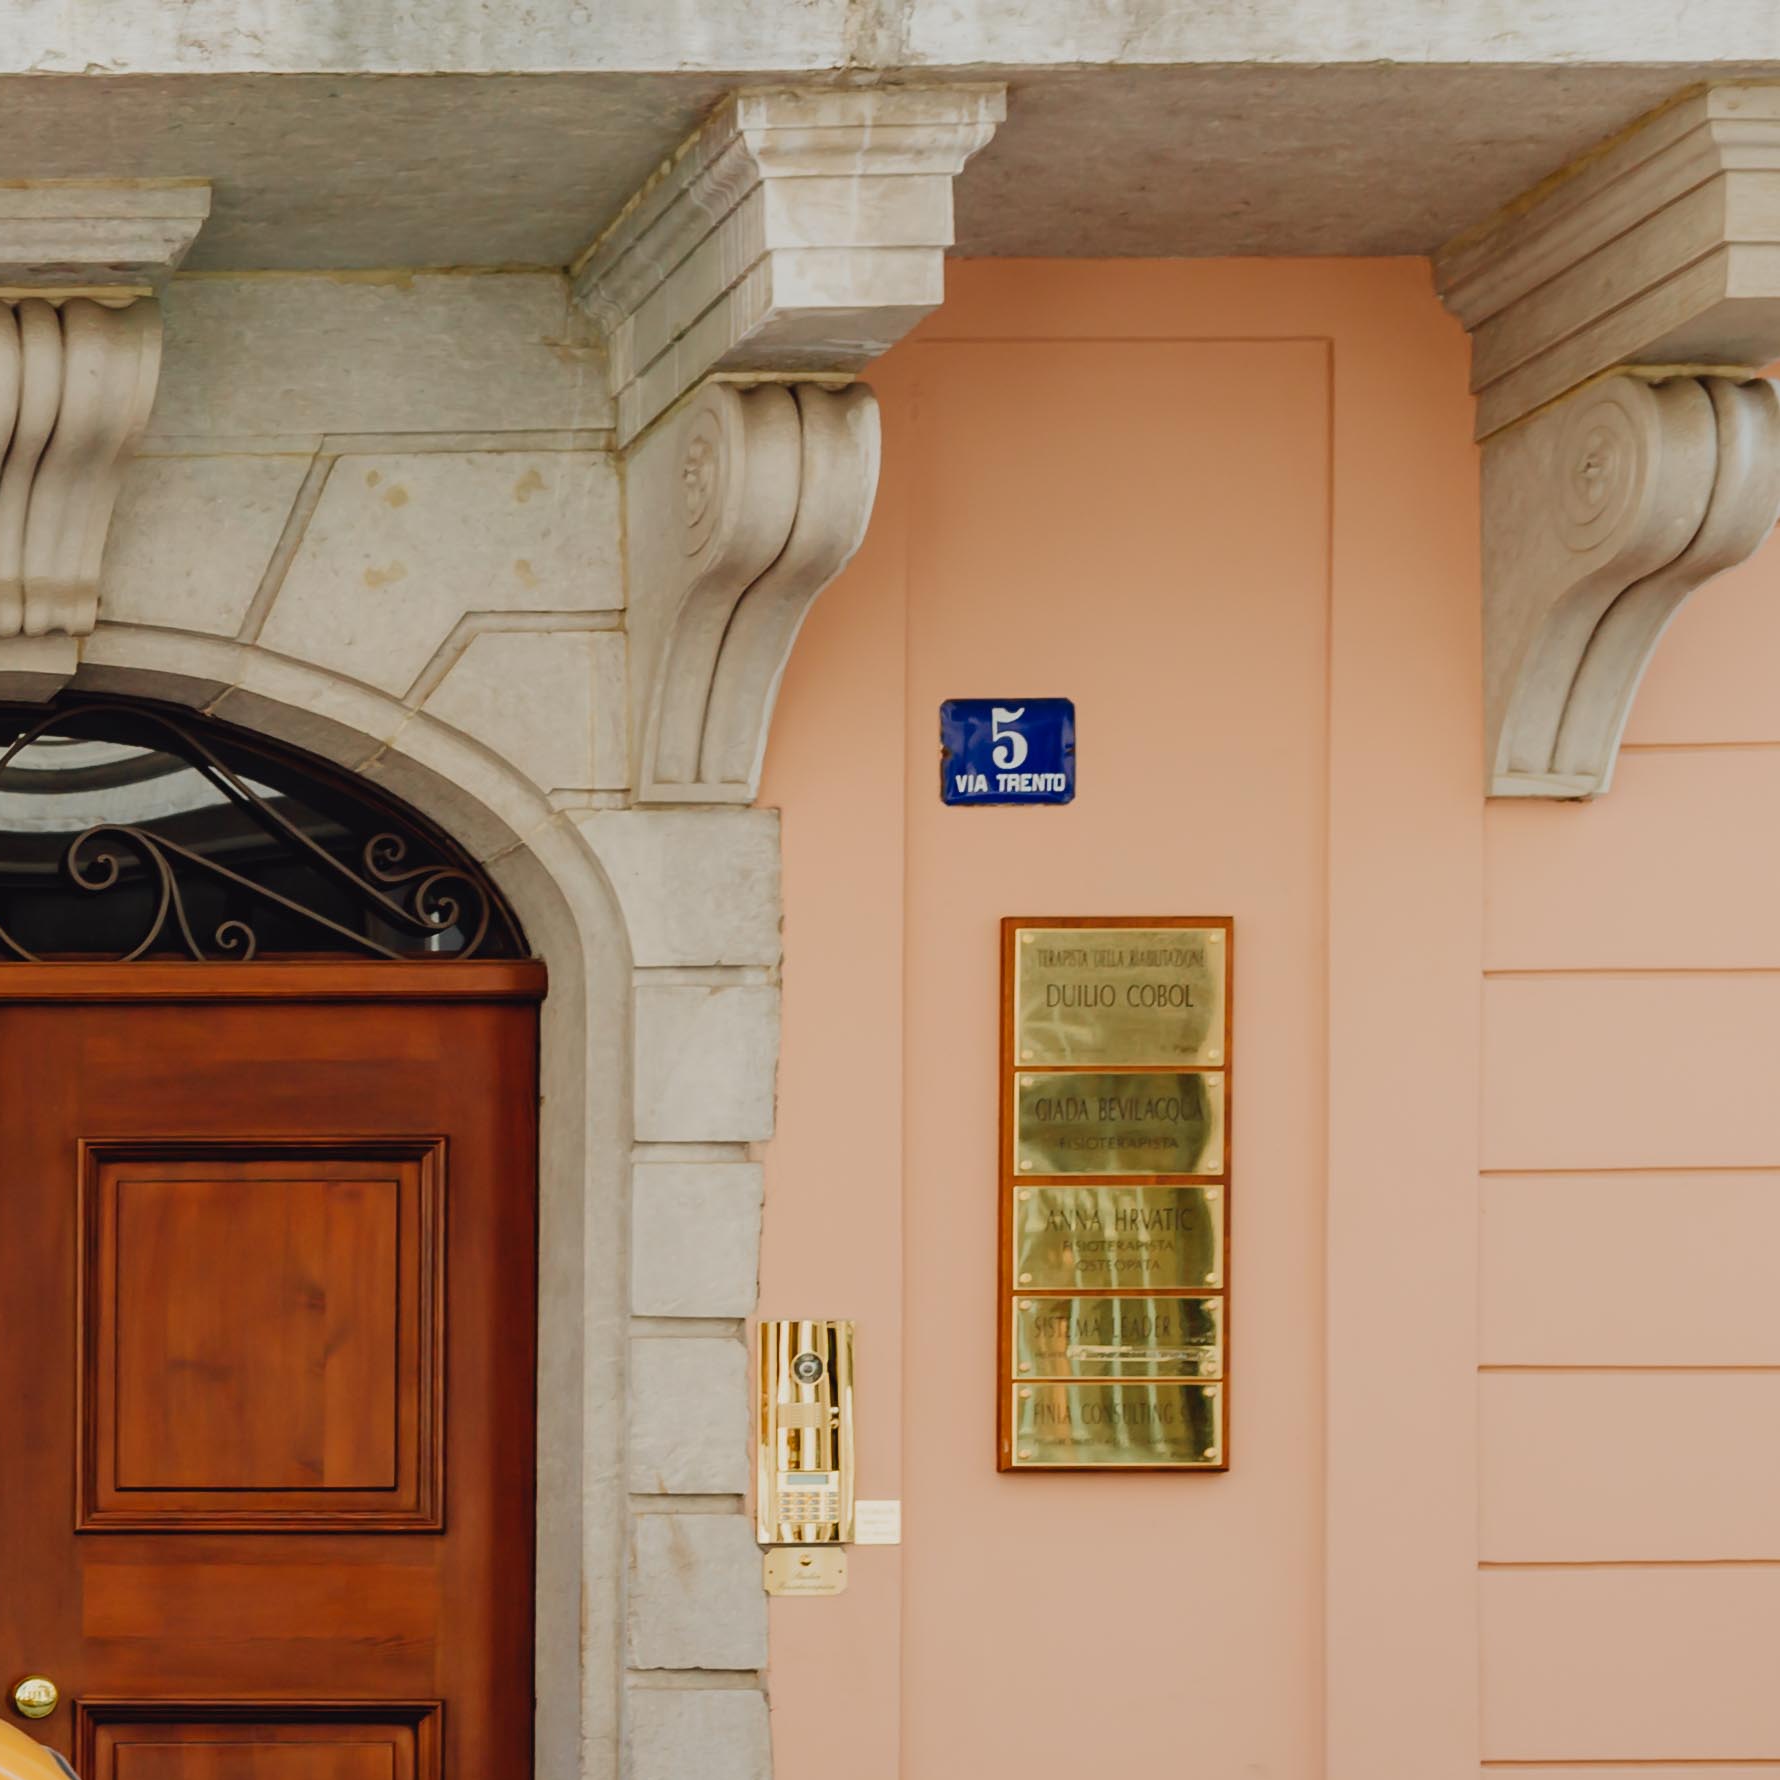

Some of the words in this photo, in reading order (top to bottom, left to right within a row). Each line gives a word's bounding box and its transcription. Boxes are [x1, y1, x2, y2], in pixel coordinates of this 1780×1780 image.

[990, 706, 1029, 770] 5
[955, 774, 989, 793] VIA
[996, 773, 1066, 792] TRENTO
[1046, 984, 1115, 1007] DUILIO
[1127, 984, 1194, 1008] COBOL
[1035, 1097, 1089, 1121] GIADA
[1098, 1097, 1204, 1123] BEVILACQUA
[1044, 1208, 1103, 1232] ANNA
